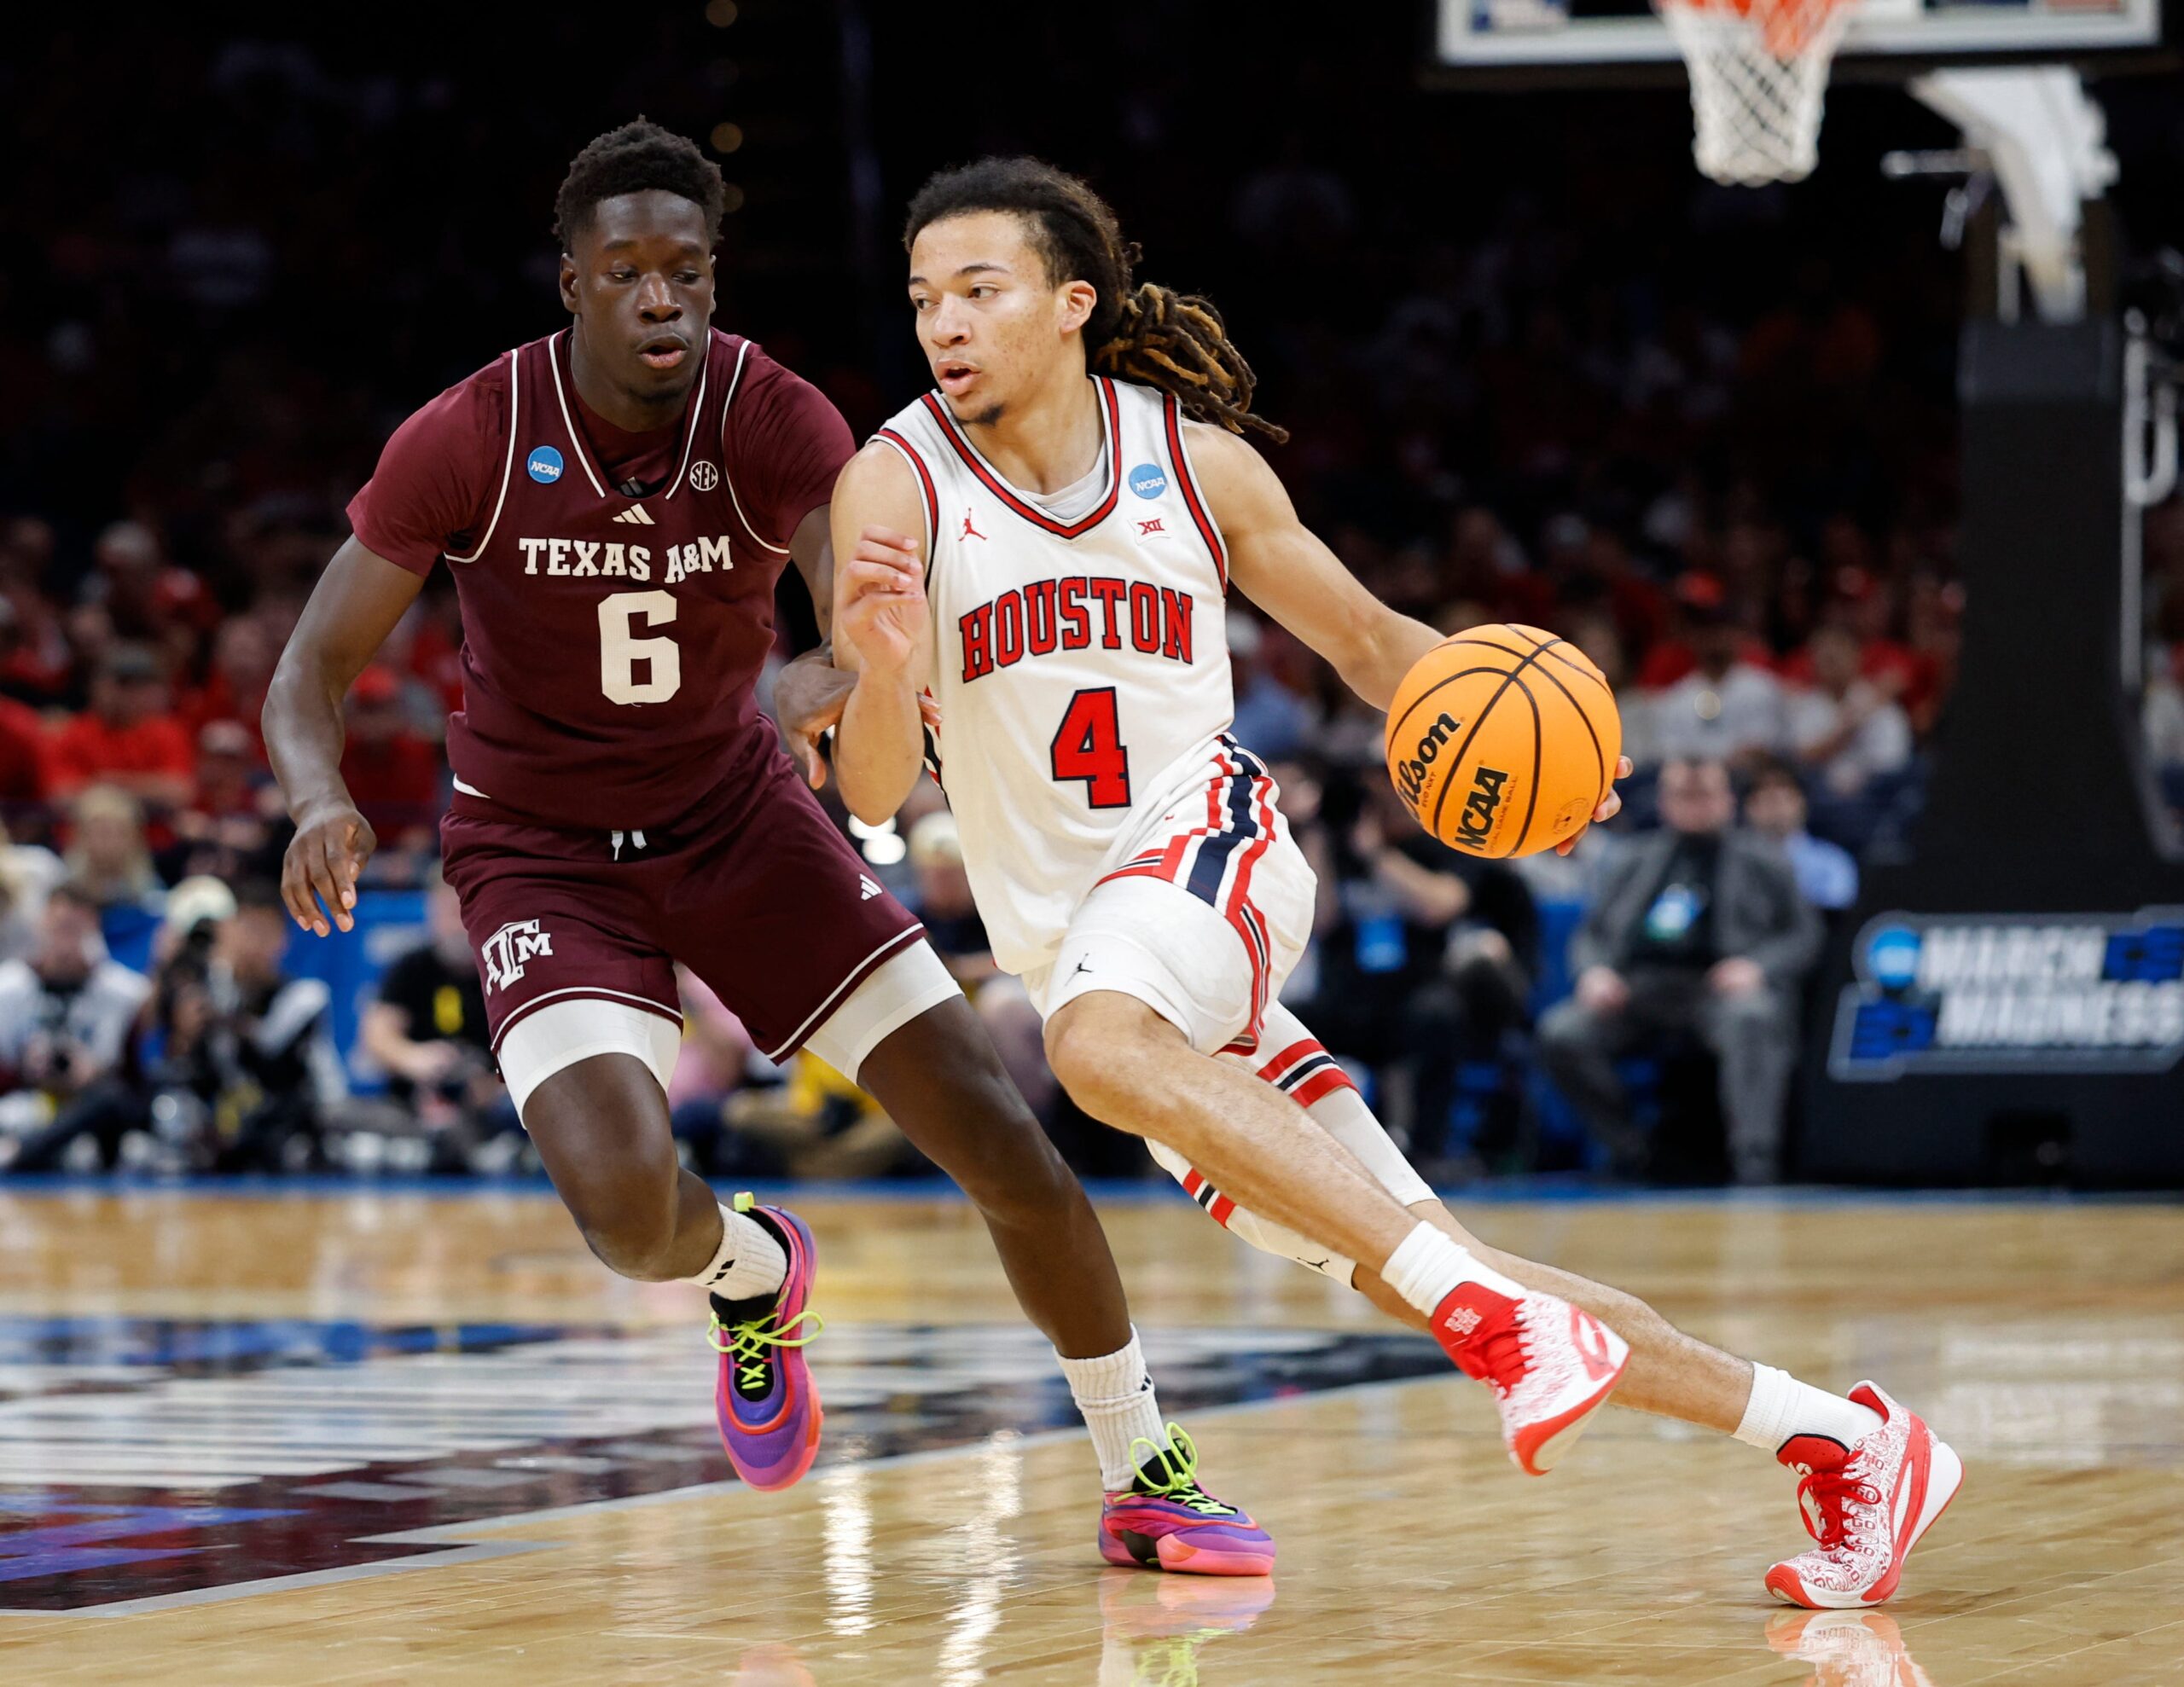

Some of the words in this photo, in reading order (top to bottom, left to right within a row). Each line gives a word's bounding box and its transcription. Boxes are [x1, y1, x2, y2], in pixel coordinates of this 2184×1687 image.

[531, 461, 560, 477] NCAA
[690, 462, 718, 490] SEC
[1136, 477, 1165, 493] NCAA
[1137, 518, 1165, 536] XII
[519, 538, 651, 582] TEXAS
[664, 536, 734, 583] A&M
[598, 589, 681, 705] 6
[958, 576, 1193, 684] HOUSTON
[1050, 686, 1131, 809] 4
[1397, 712, 1461, 820] ilson
[1426, 771, 1437, 790] NXT
[1505, 775, 1519, 803] BALL
[1455, 767, 1508, 851] NCAA
[1919, 926, 2106, 991] MARCH
[1851, 1517, 1876, 1530] GO
